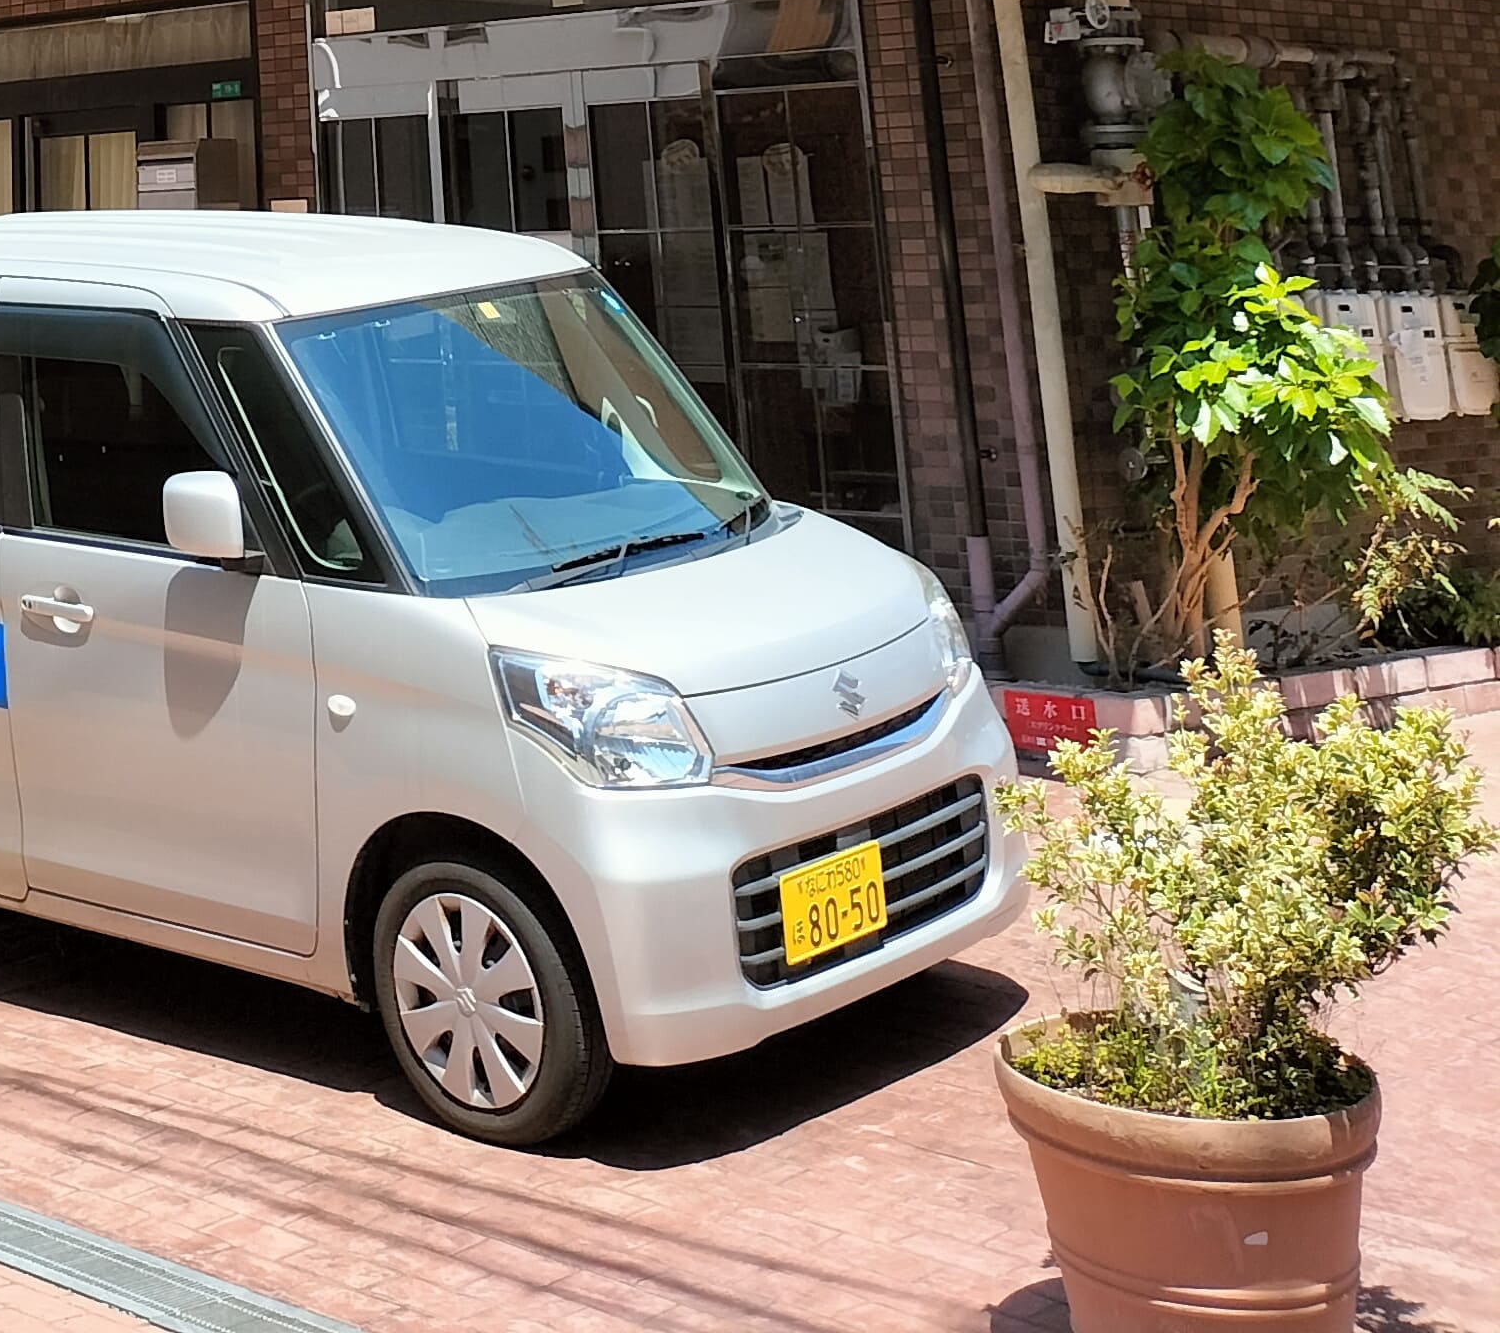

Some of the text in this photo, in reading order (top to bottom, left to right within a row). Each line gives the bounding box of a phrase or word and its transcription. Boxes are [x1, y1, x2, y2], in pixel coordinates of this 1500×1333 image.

[1014, 697, 1086, 721] 送水口
[809, 881, 880, 947] 80-50
